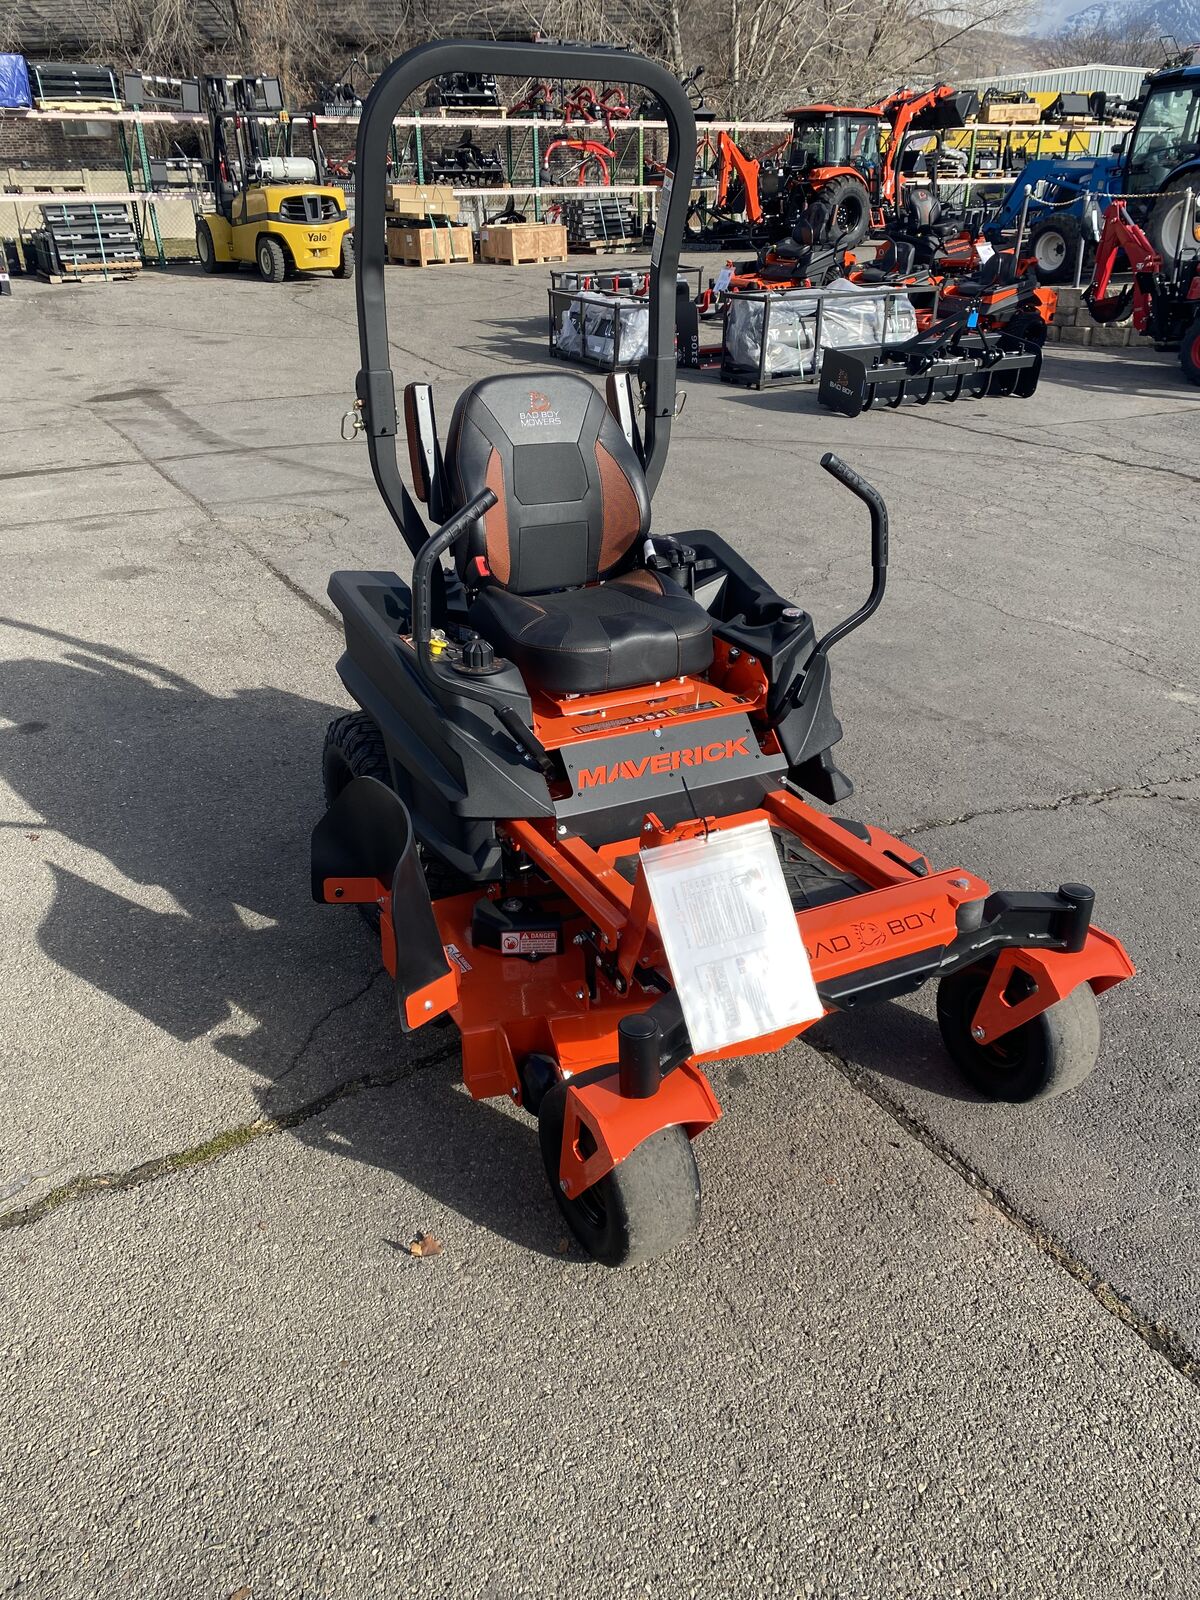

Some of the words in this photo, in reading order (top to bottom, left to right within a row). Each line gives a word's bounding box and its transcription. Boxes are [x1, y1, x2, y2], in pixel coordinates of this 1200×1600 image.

[308, 233, 327, 242] Yale
[690, 334, 699, 364] 3106
[829, 380, 842, 391] BAD
[842, 386, 854, 396] BOY
[519, 411, 538, 420] BAD
[541, 410, 560, 418] BOY
[520, 417, 562, 427] MOWERS
[577, 736, 750, 791] MAVERICK
[886, 908, 937, 936] BOY
